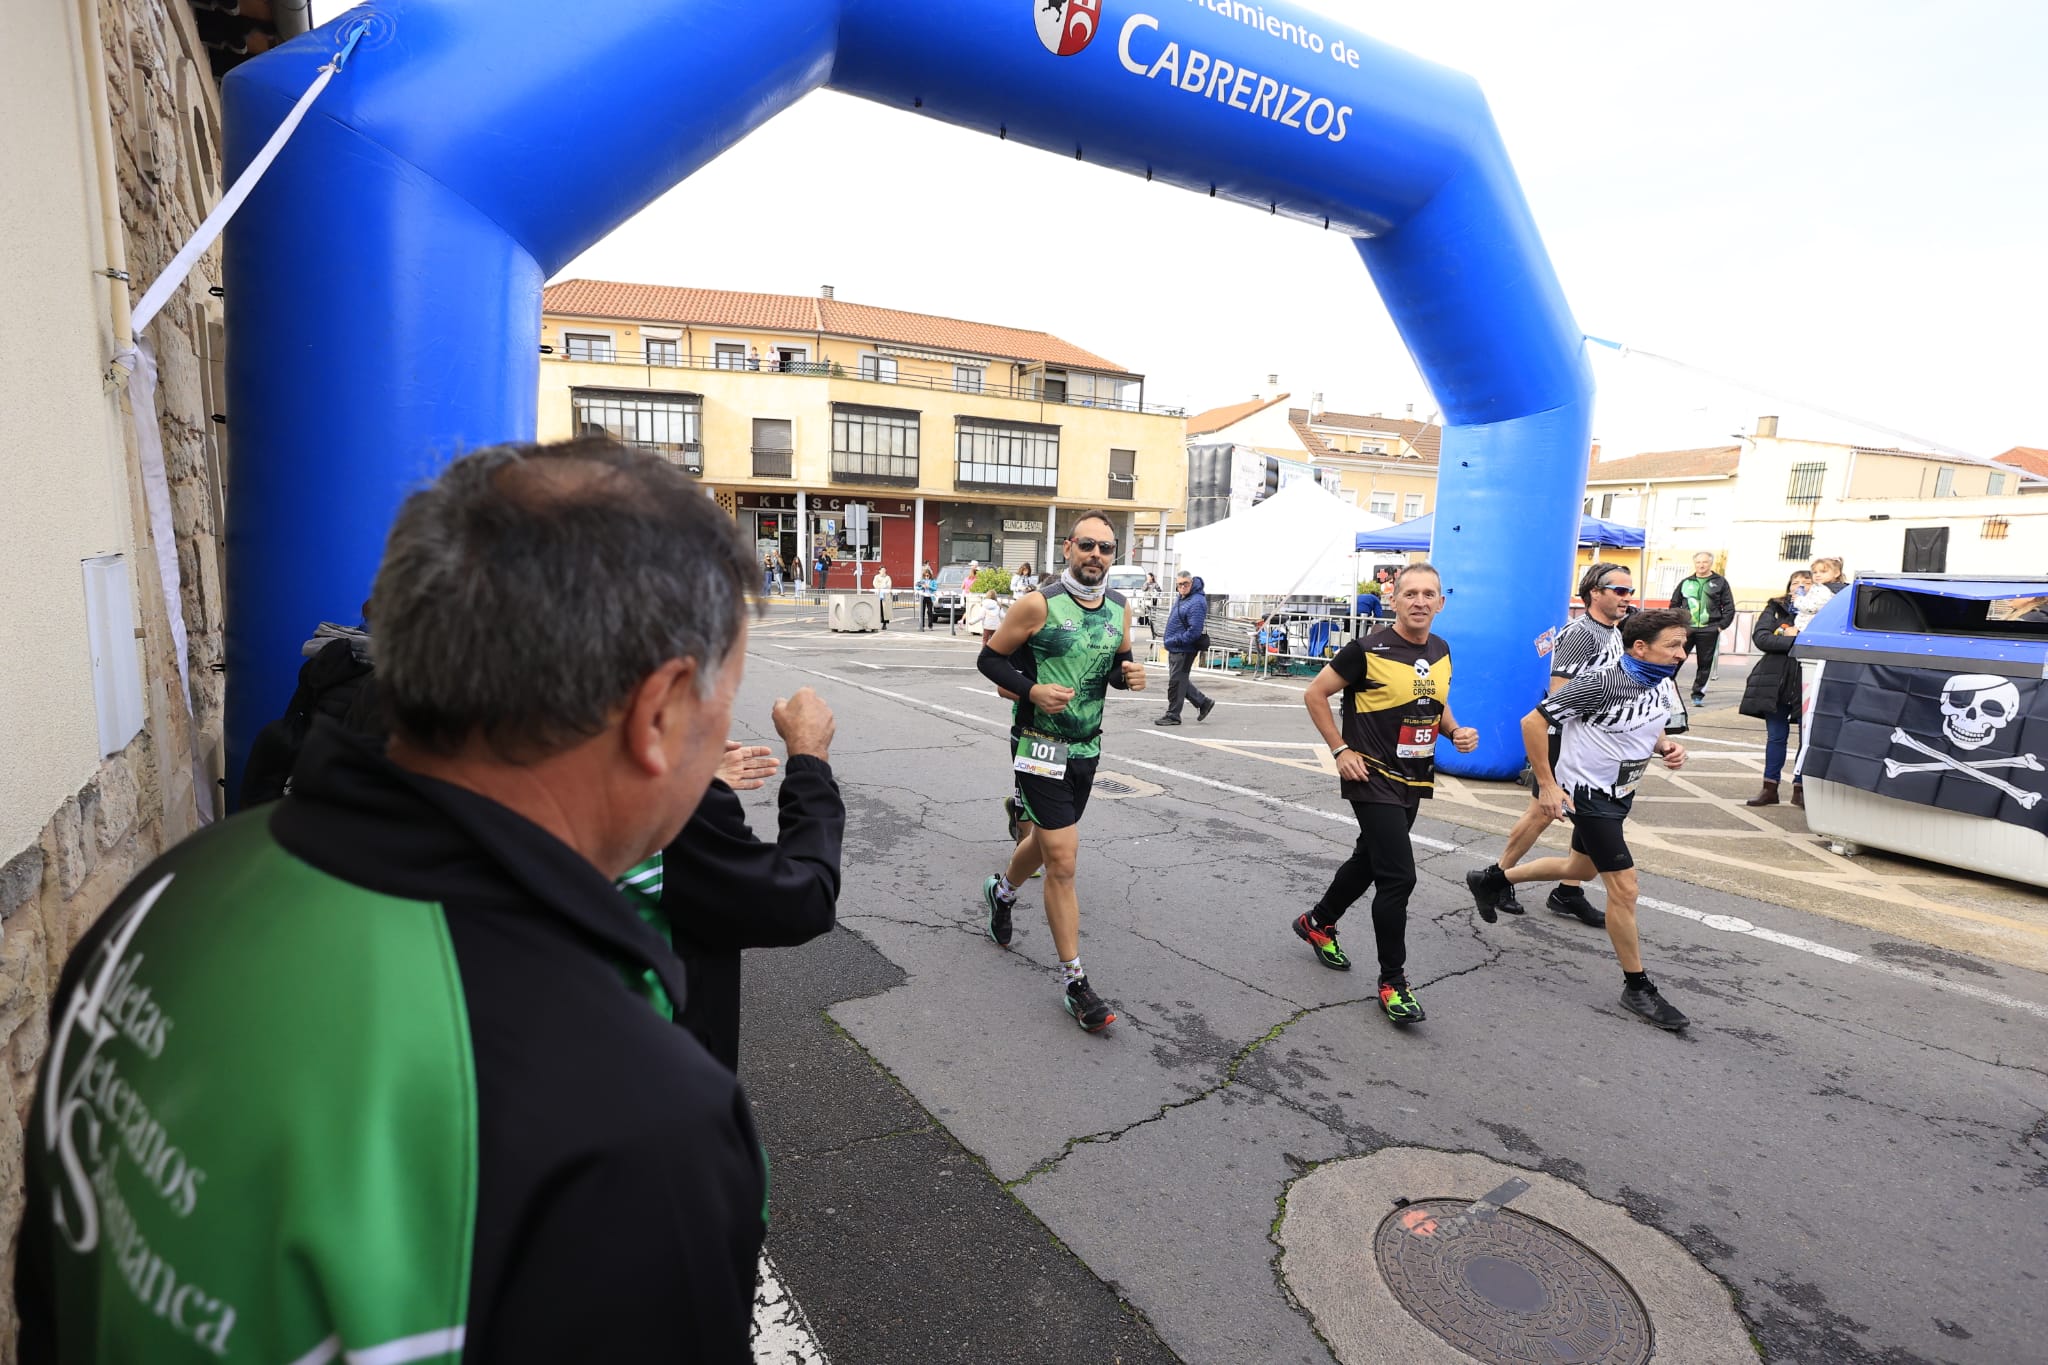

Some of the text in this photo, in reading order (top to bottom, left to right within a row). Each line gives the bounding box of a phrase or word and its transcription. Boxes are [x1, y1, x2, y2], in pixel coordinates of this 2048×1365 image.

[1330, 40, 1360, 69] de
[1117, 13, 1353, 142] CABRERIZOS
[1413, 688, 1436, 696] CROSS
[1414, 728, 1433, 744] 55
[1031, 742, 1056, 761] 101
